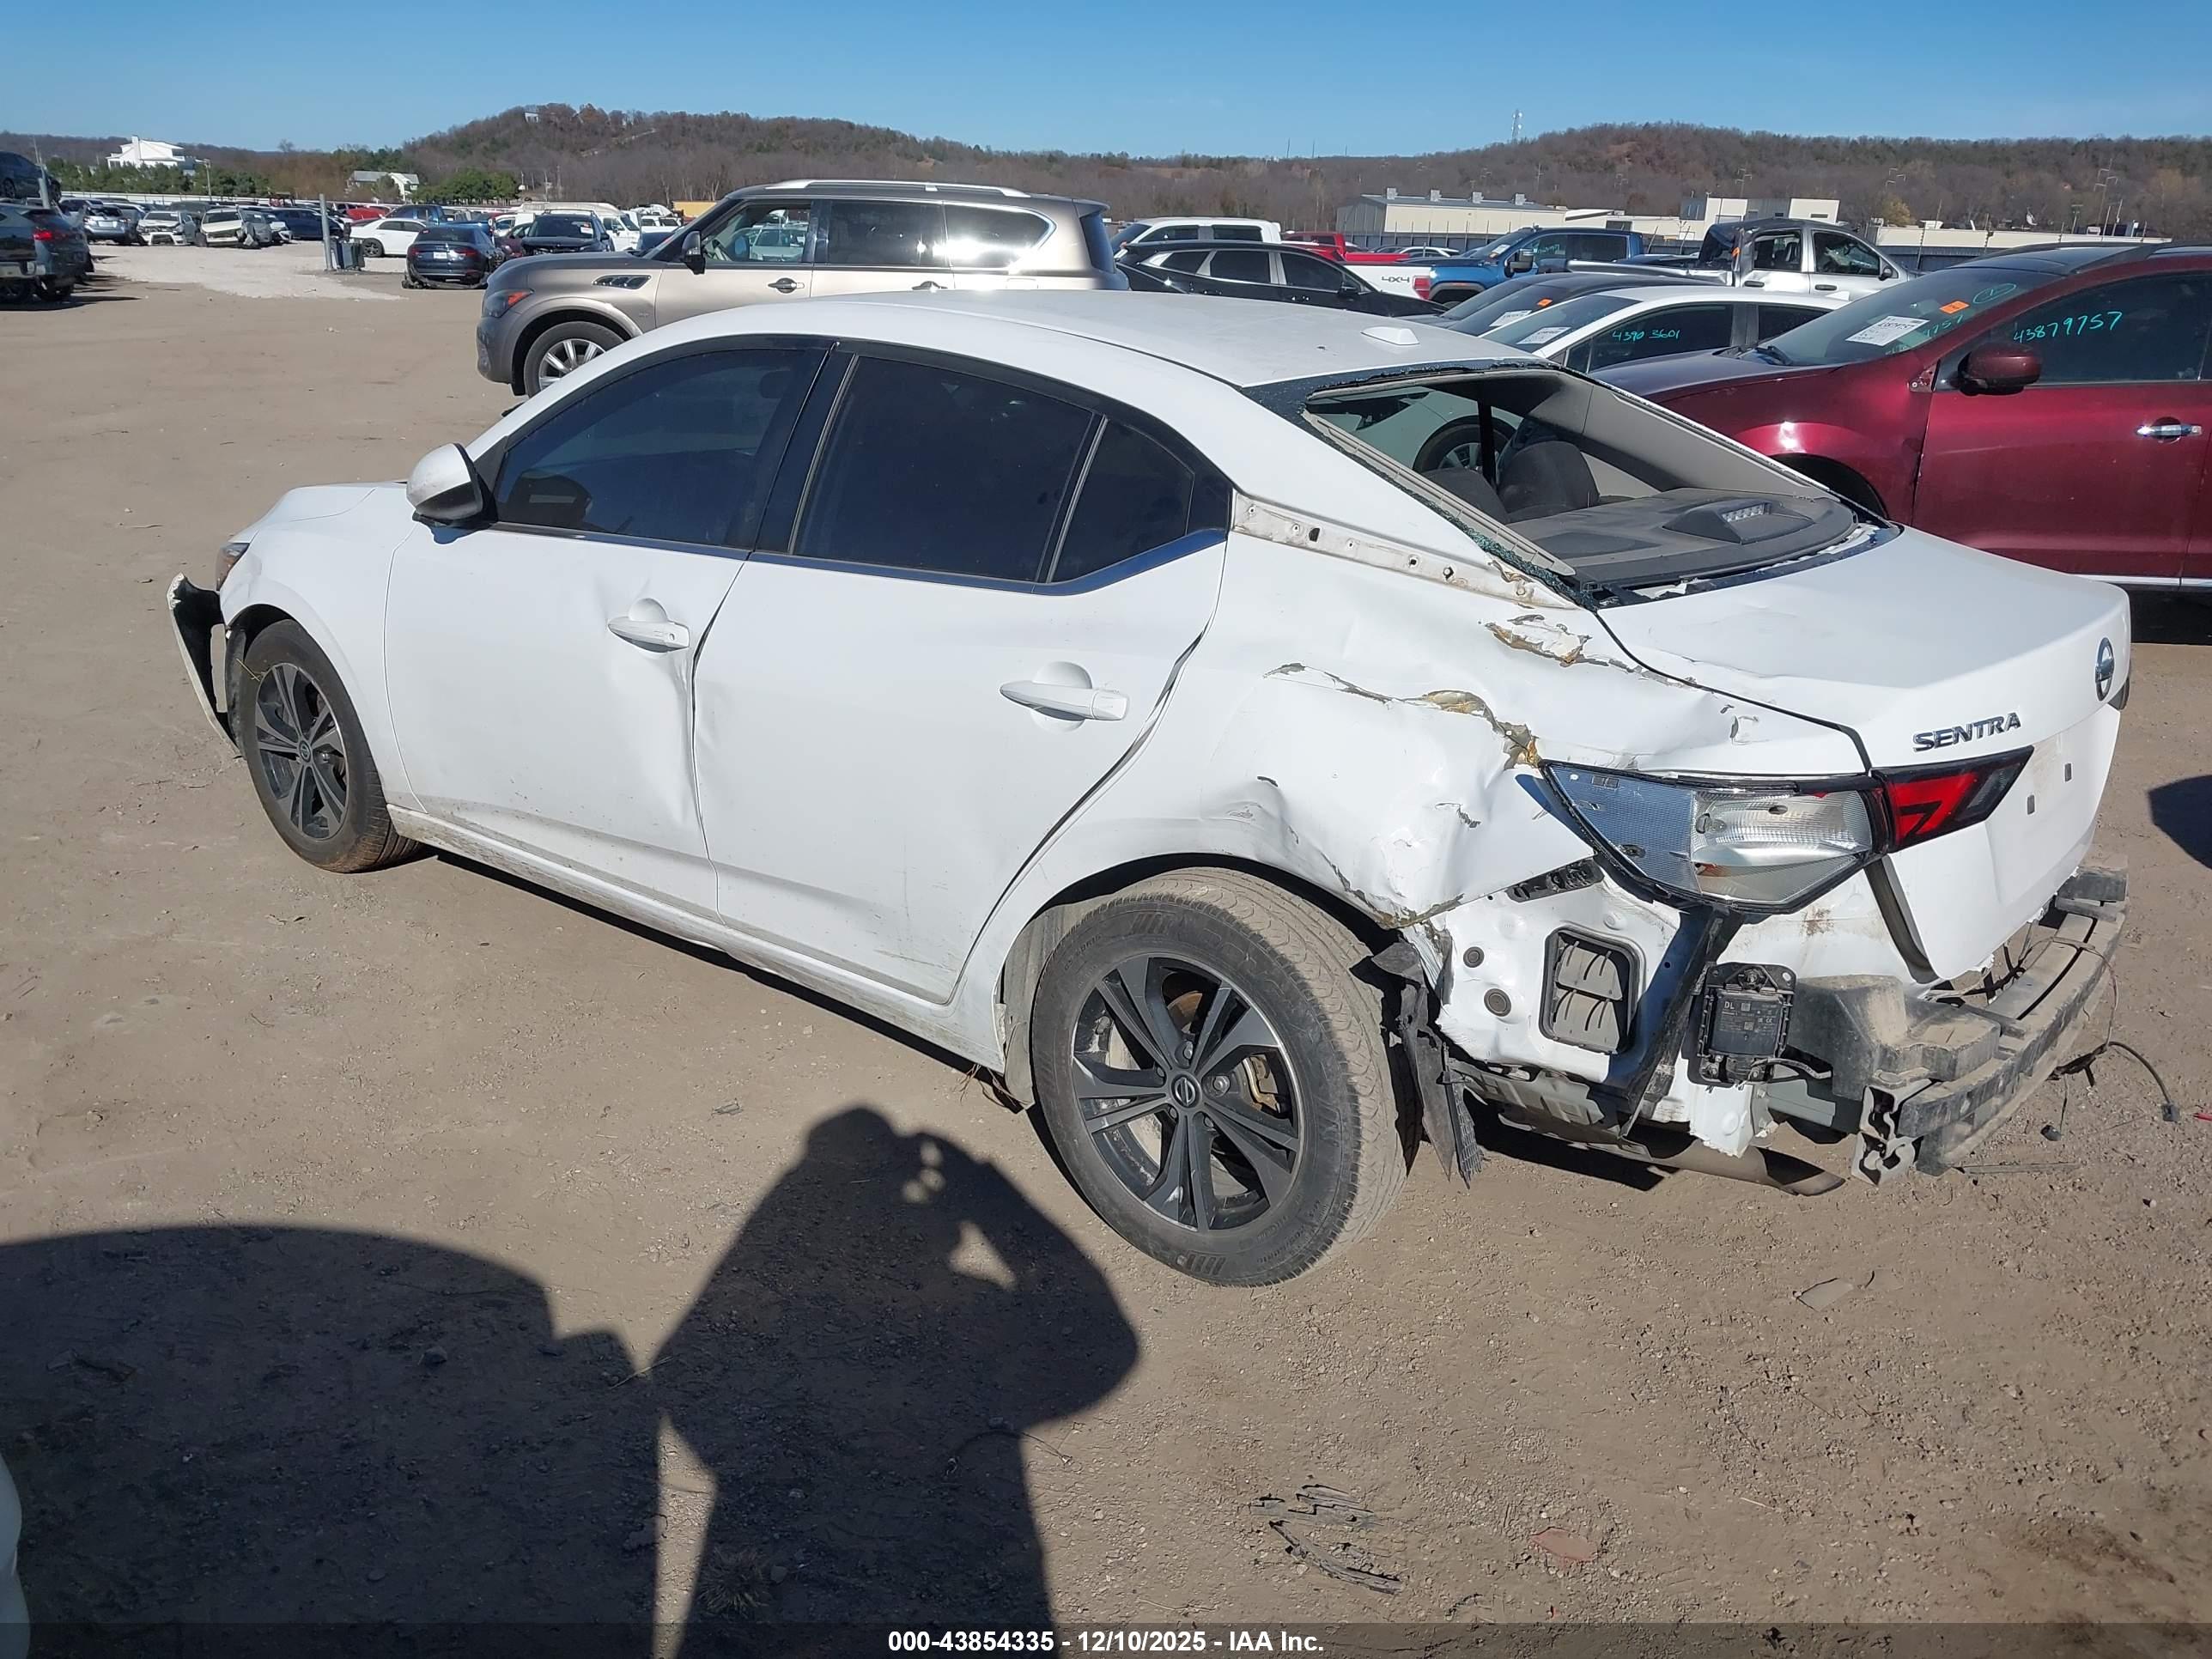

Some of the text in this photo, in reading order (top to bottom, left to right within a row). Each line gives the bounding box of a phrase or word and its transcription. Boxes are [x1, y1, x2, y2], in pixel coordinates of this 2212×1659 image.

[1612, 328, 1680, 342] 4390 3601
[2013, 311, 2123, 343] 43879757
[1912, 712, 2021, 752] SENTRA
[1724, 1000, 1735, 1010] DL
